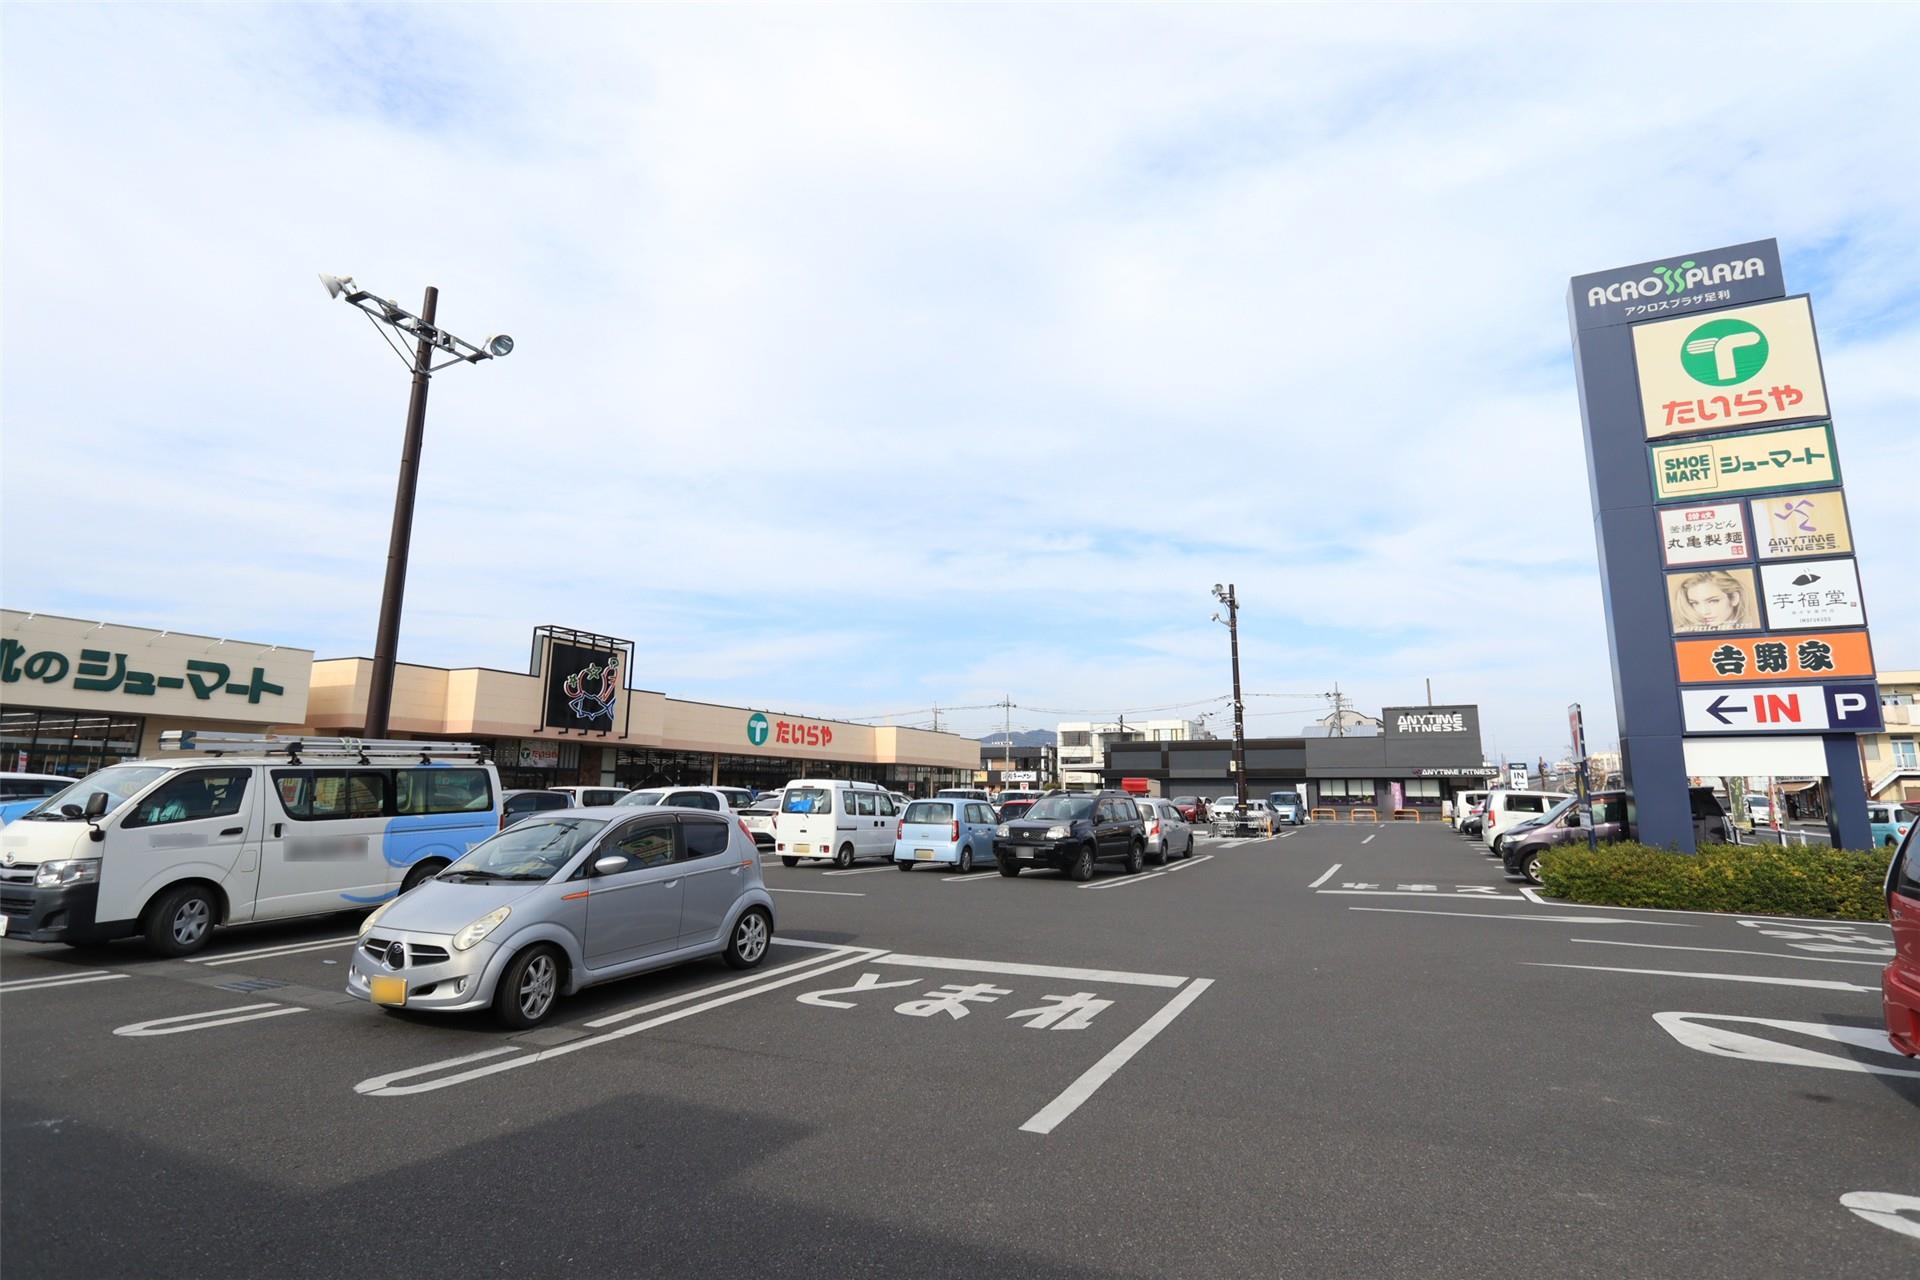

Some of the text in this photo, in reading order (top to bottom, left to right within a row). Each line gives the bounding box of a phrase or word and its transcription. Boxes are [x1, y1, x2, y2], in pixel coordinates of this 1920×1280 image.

[1625, 289, 1731, 316] アクロスプラザ足利
[1662, 384, 1804, 426] たいらや
[1664, 454, 1710, 471] SHOE
[1719, 447, 1825, 475] シューマート
[1665, 467, 1711, 484] MART
[1667, 531, 1743, 549] 丸亀製麺
[1768, 533, 1836, 547] ANYTIME
[1770, 541, 1837, 554] FITNESS
[1772, 590, 1847, 609] 芋福堂
[1753, 693, 1802, 723] IN
[1835, 693, 1867, 720] P
[1397, 714, 1463, 725] ANYTIME
[1399, 723, 1464, 733] FITNESS
[775, 720, 832, 747] たいらや
[1421, 768, 1497, 776] ANYTIME FITNESS
[1513, 772, 1524, 780] IN
[795, 973, 1116, 1031] とまれ
